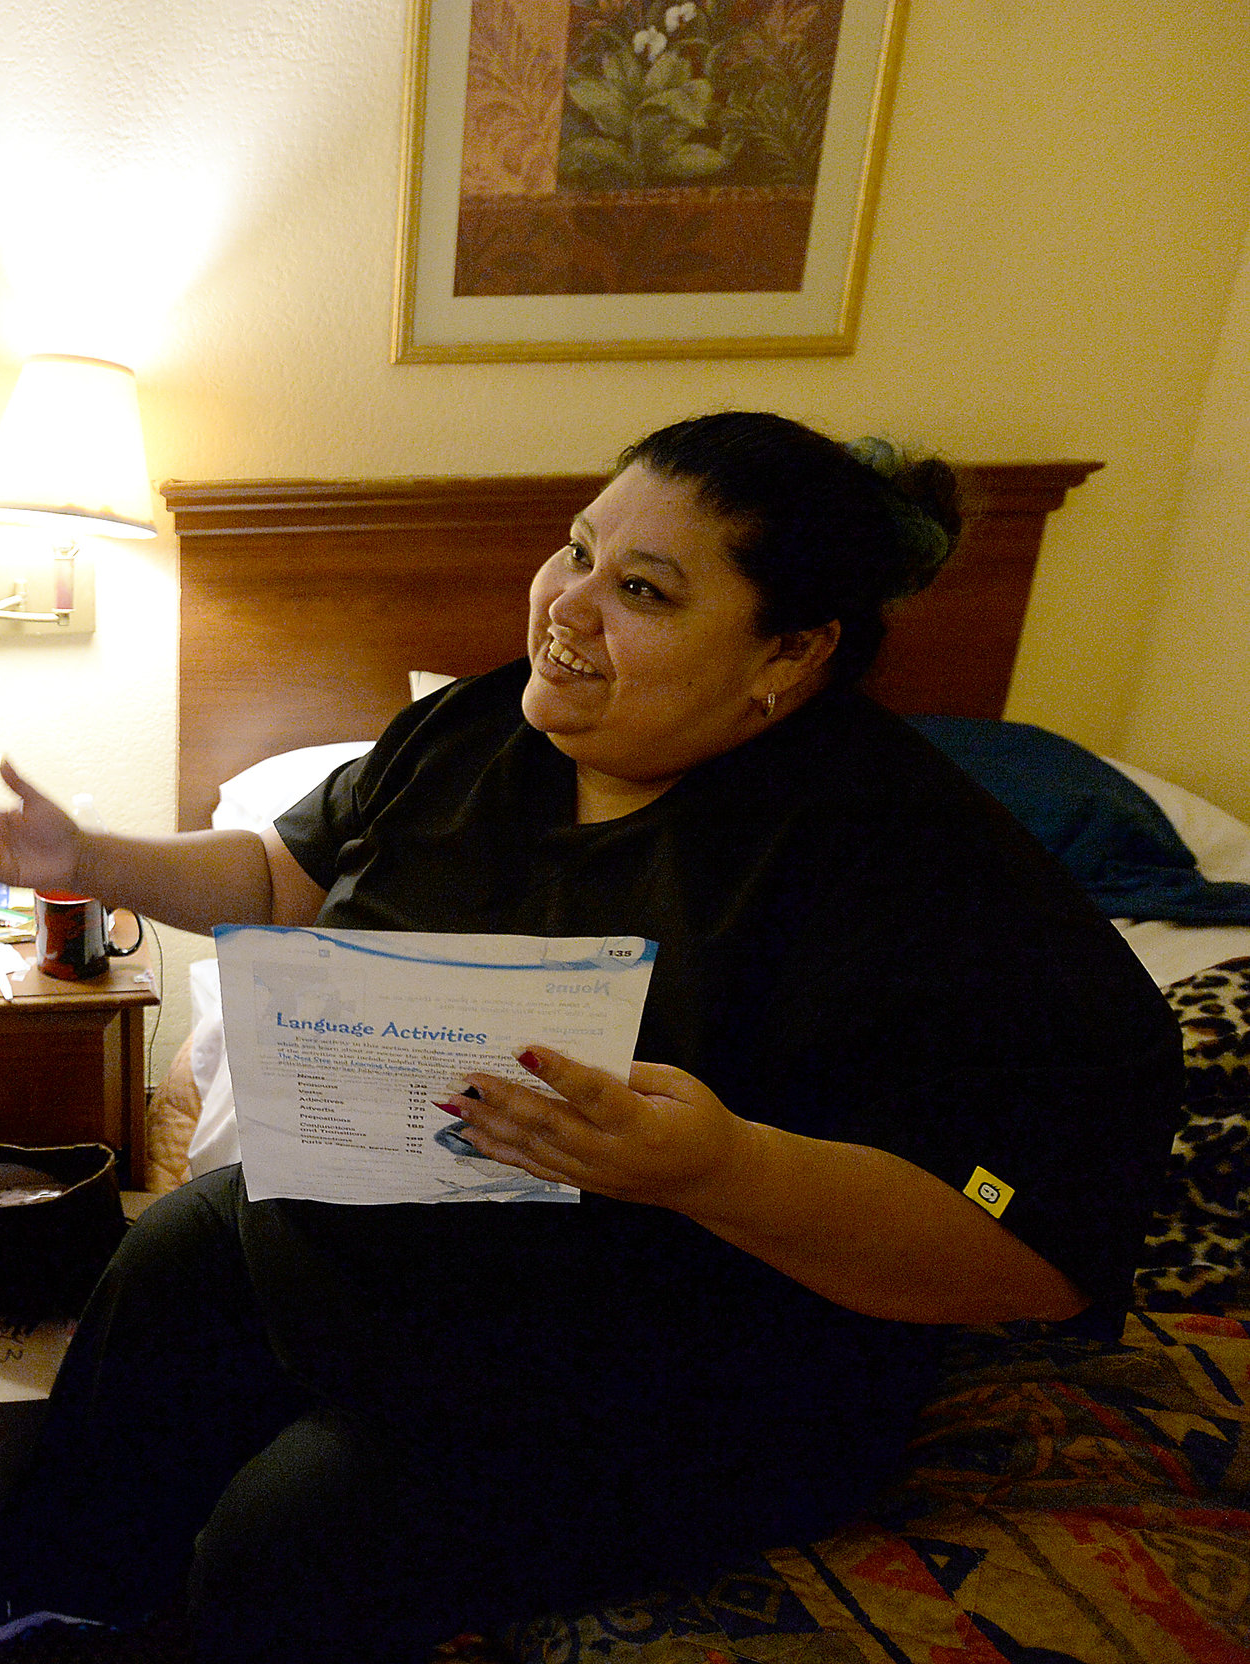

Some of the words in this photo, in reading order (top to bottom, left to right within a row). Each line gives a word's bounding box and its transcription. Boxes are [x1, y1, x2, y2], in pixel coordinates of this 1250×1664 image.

[607, 948, 633, 958] 135
[277, 1012, 375, 1037] Language
[381, 1021, 488, 1045] Activities
[298, 1081, 338, 1089] Pronouns
[299, 1097, 344, 1105] Adjectives
[300, 1105, 335, 1113] Adverbs
[300, 1113, 351, 1123] Prepositions
[300, 1122, 356, 1131] Conjunctions
